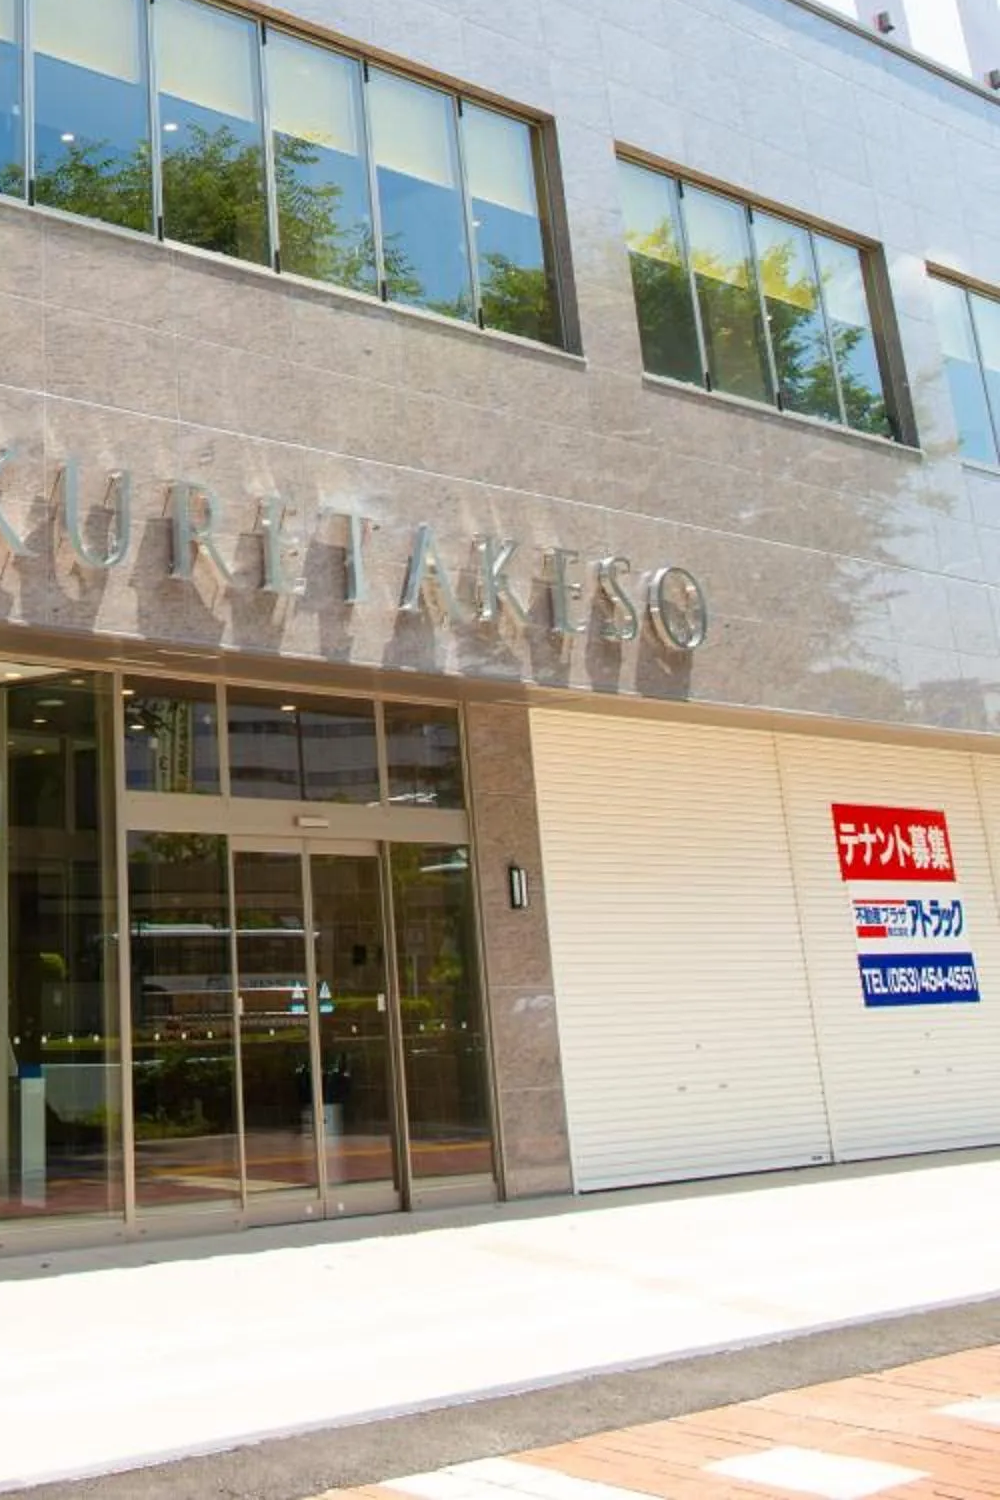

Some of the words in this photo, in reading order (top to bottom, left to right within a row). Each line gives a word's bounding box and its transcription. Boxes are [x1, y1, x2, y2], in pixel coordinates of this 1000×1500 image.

[839, 822, 950, 870] テナント募集
[906, 899, 963, 938] アトラック
